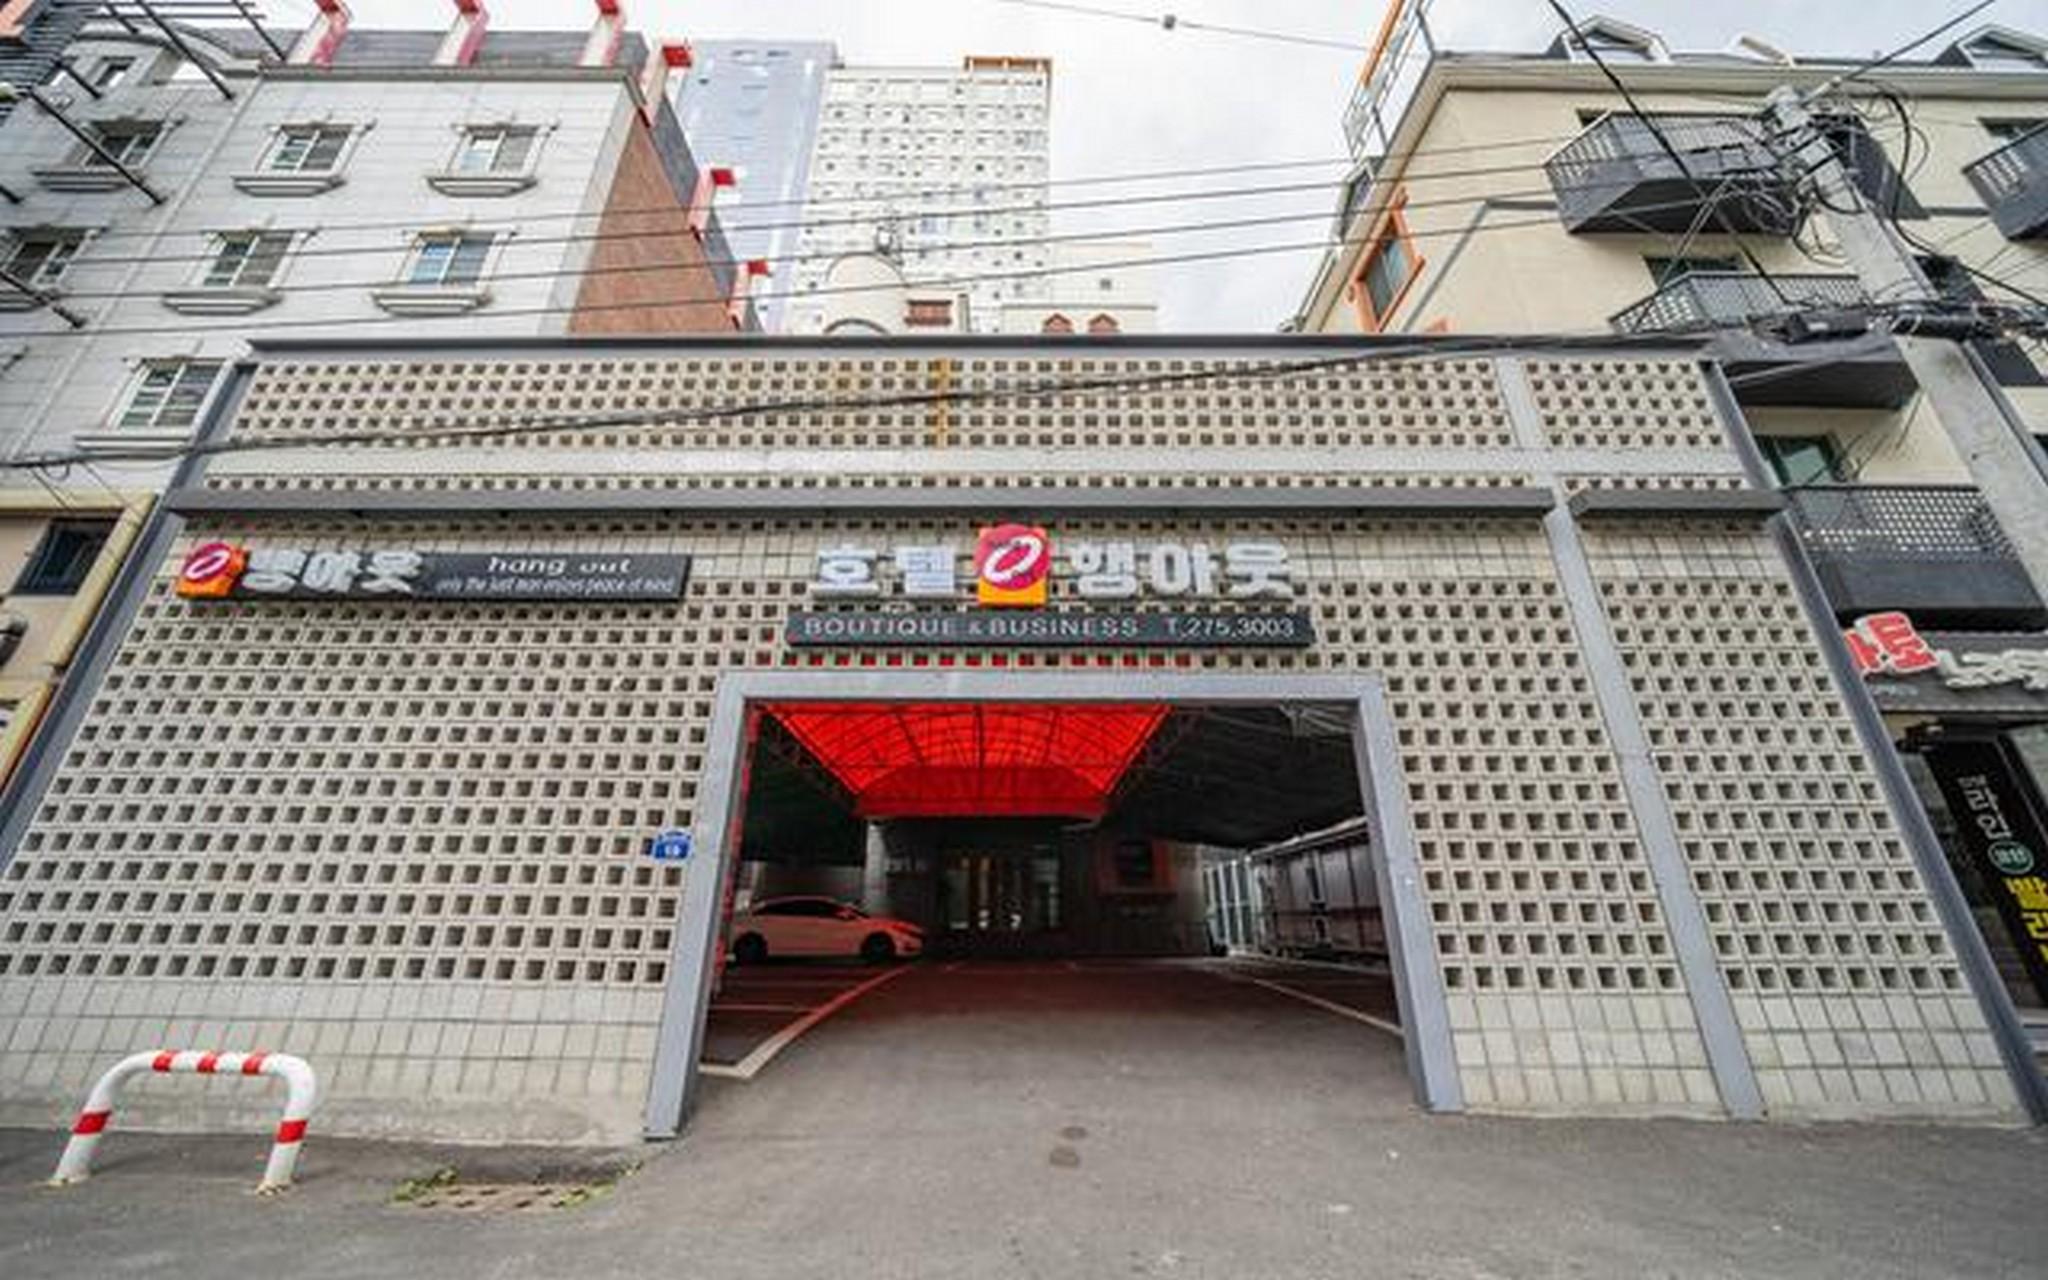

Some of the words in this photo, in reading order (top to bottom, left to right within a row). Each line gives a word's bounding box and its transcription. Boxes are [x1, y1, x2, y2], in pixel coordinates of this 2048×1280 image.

[489, 556, 566, 576] hang
[580, 559, 630, 573] out
[807, 543, 958, 597] 호텔
[1071, 542, 1295, 599] 행아웃
[804, 617, 956, 637] BOUTIQUE
[968, 620, 983, 635] &
[990, 617, 1138, 637] BUSINESS
